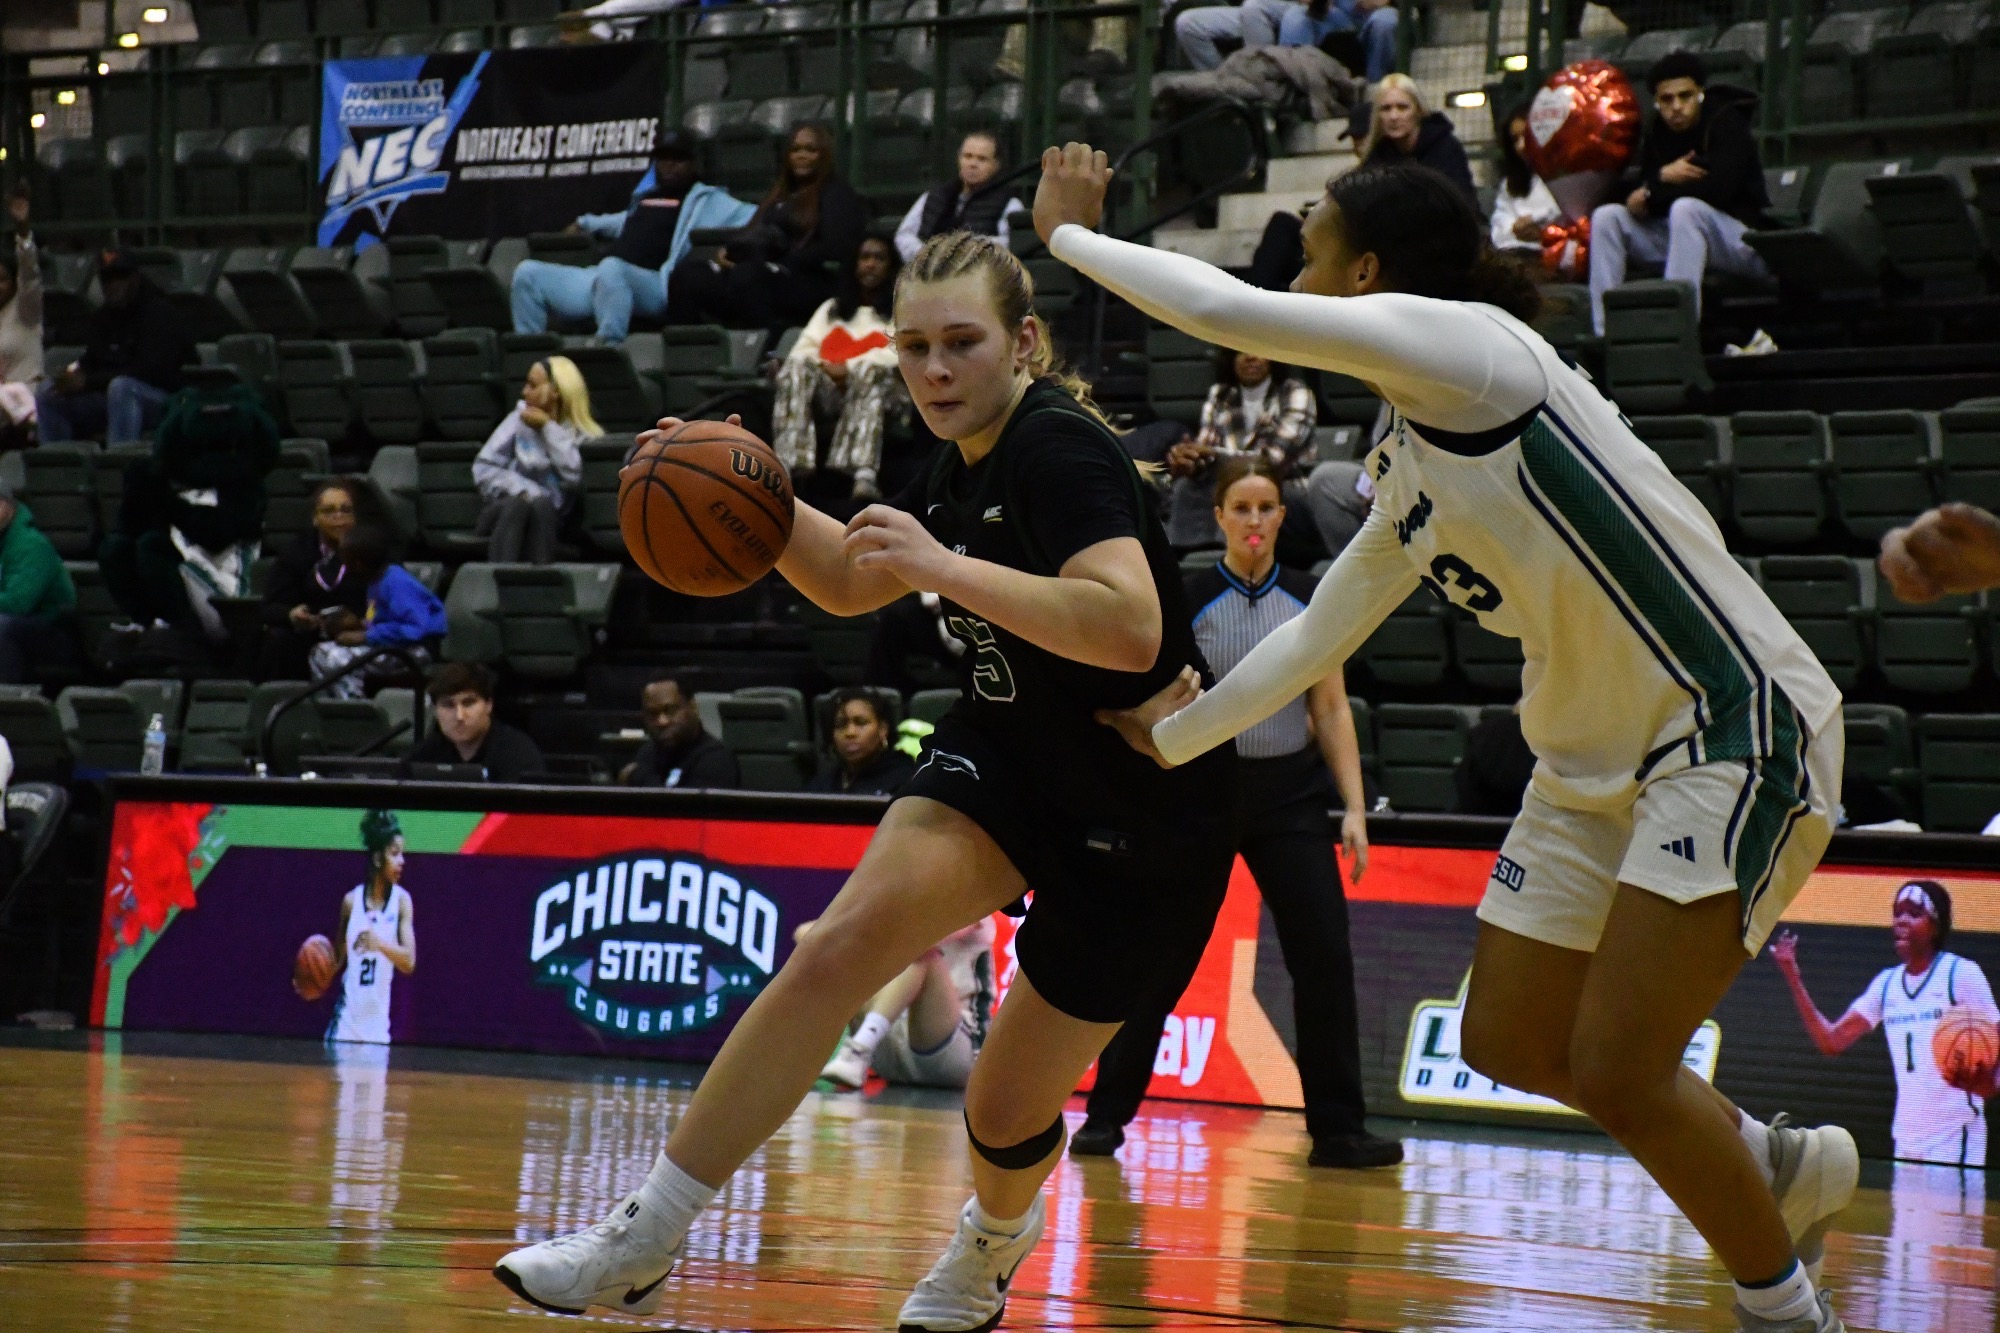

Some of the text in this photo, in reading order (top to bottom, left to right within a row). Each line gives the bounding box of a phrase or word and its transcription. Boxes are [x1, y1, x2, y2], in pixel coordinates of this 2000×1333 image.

[325, 114, 448, 207] NEC
[454, 117, 659, 163] NORTHEAST CONFERENCE
[530, 858, 779, 975] CHICAGO
[360, 957, 377, 986] 21
[598, 939, 703, 985] STATE
[574, 986, 719, 1033] COUGARS
[1906, 1032, 1914, 1073] 1
